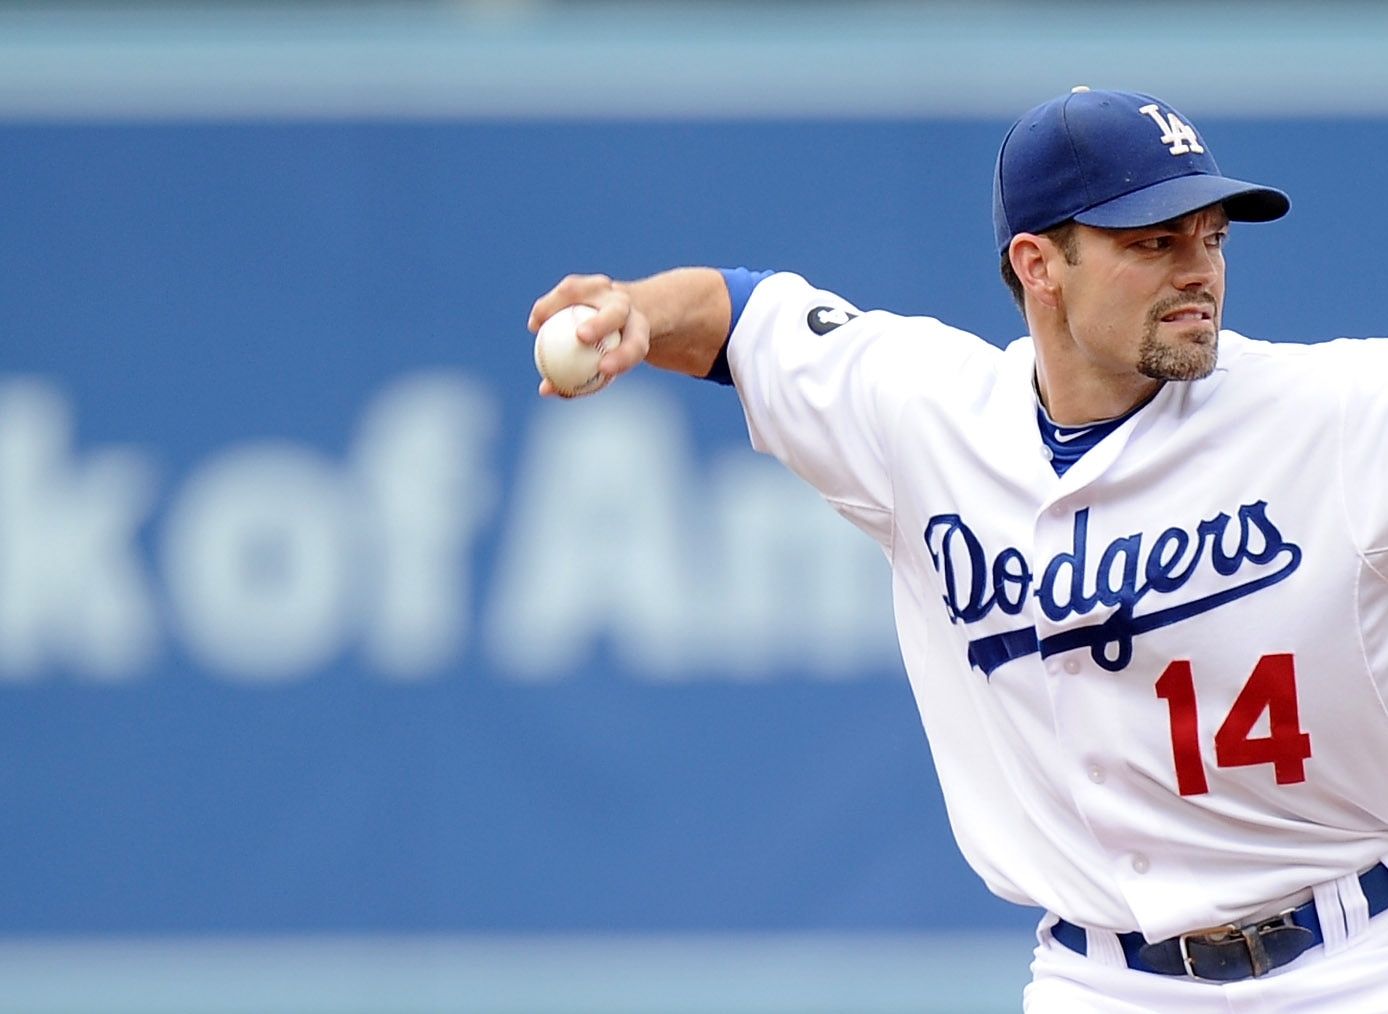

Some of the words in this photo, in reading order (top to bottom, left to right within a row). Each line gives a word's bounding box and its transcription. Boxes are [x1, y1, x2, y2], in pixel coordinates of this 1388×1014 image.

[1139, 104, 1204, 155] LA
[165, 371, 500, 682] of
[924, 500, 1302, 672] Dodgers
[1155, 653, 1312, 796] 14
